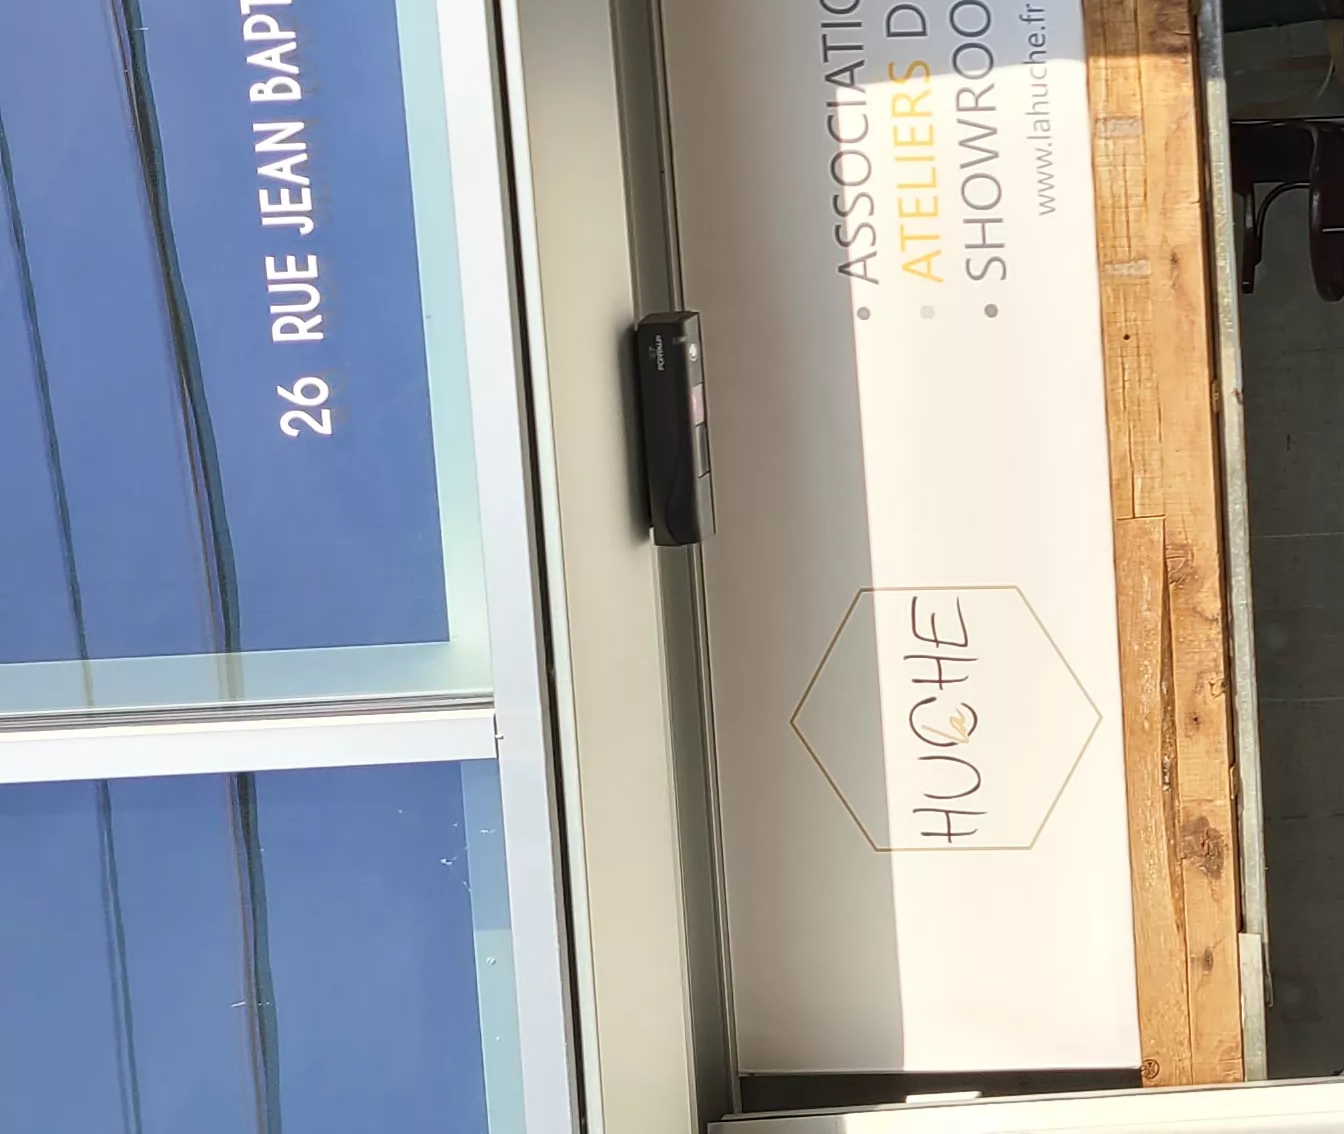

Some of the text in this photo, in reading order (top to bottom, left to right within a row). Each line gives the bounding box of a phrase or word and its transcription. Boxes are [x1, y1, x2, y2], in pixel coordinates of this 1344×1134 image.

[252, 121, 315, 235] JEAN
[888, 59, 944, 284] ATELIERS
[1019, 3, 1057, 216] www.lahuche.fr
[264, 254, 323, 342] RUE
[277, 376, 333, 436] 26
[903, 595, 987, 843] HUCHE
